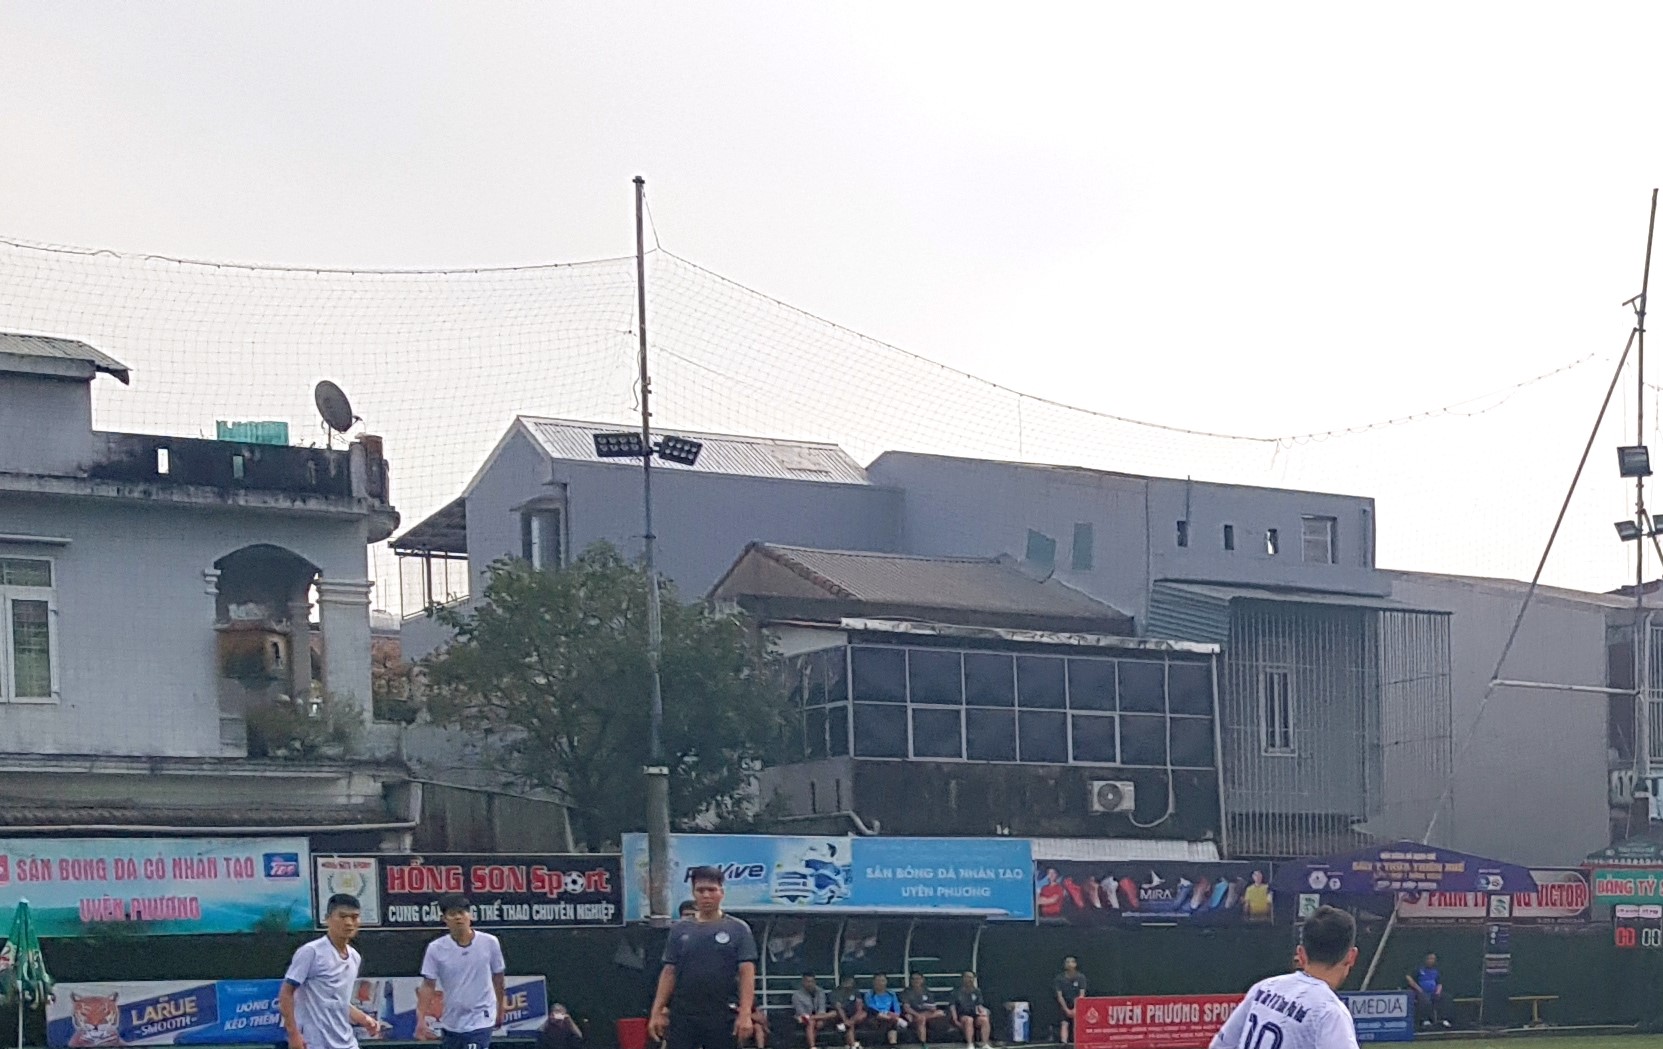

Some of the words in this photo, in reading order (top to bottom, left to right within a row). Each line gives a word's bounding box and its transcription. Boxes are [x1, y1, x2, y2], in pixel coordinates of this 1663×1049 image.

[1140, 889, 1172, 900] MIRA
[1537, 881, 1585, 908] VICTOR
[130, 995, 199, 1026] LARUE
[1352, 998, 1403, 1015] MEDIA
[140, 1015, 191, 1036] SMOOTH
